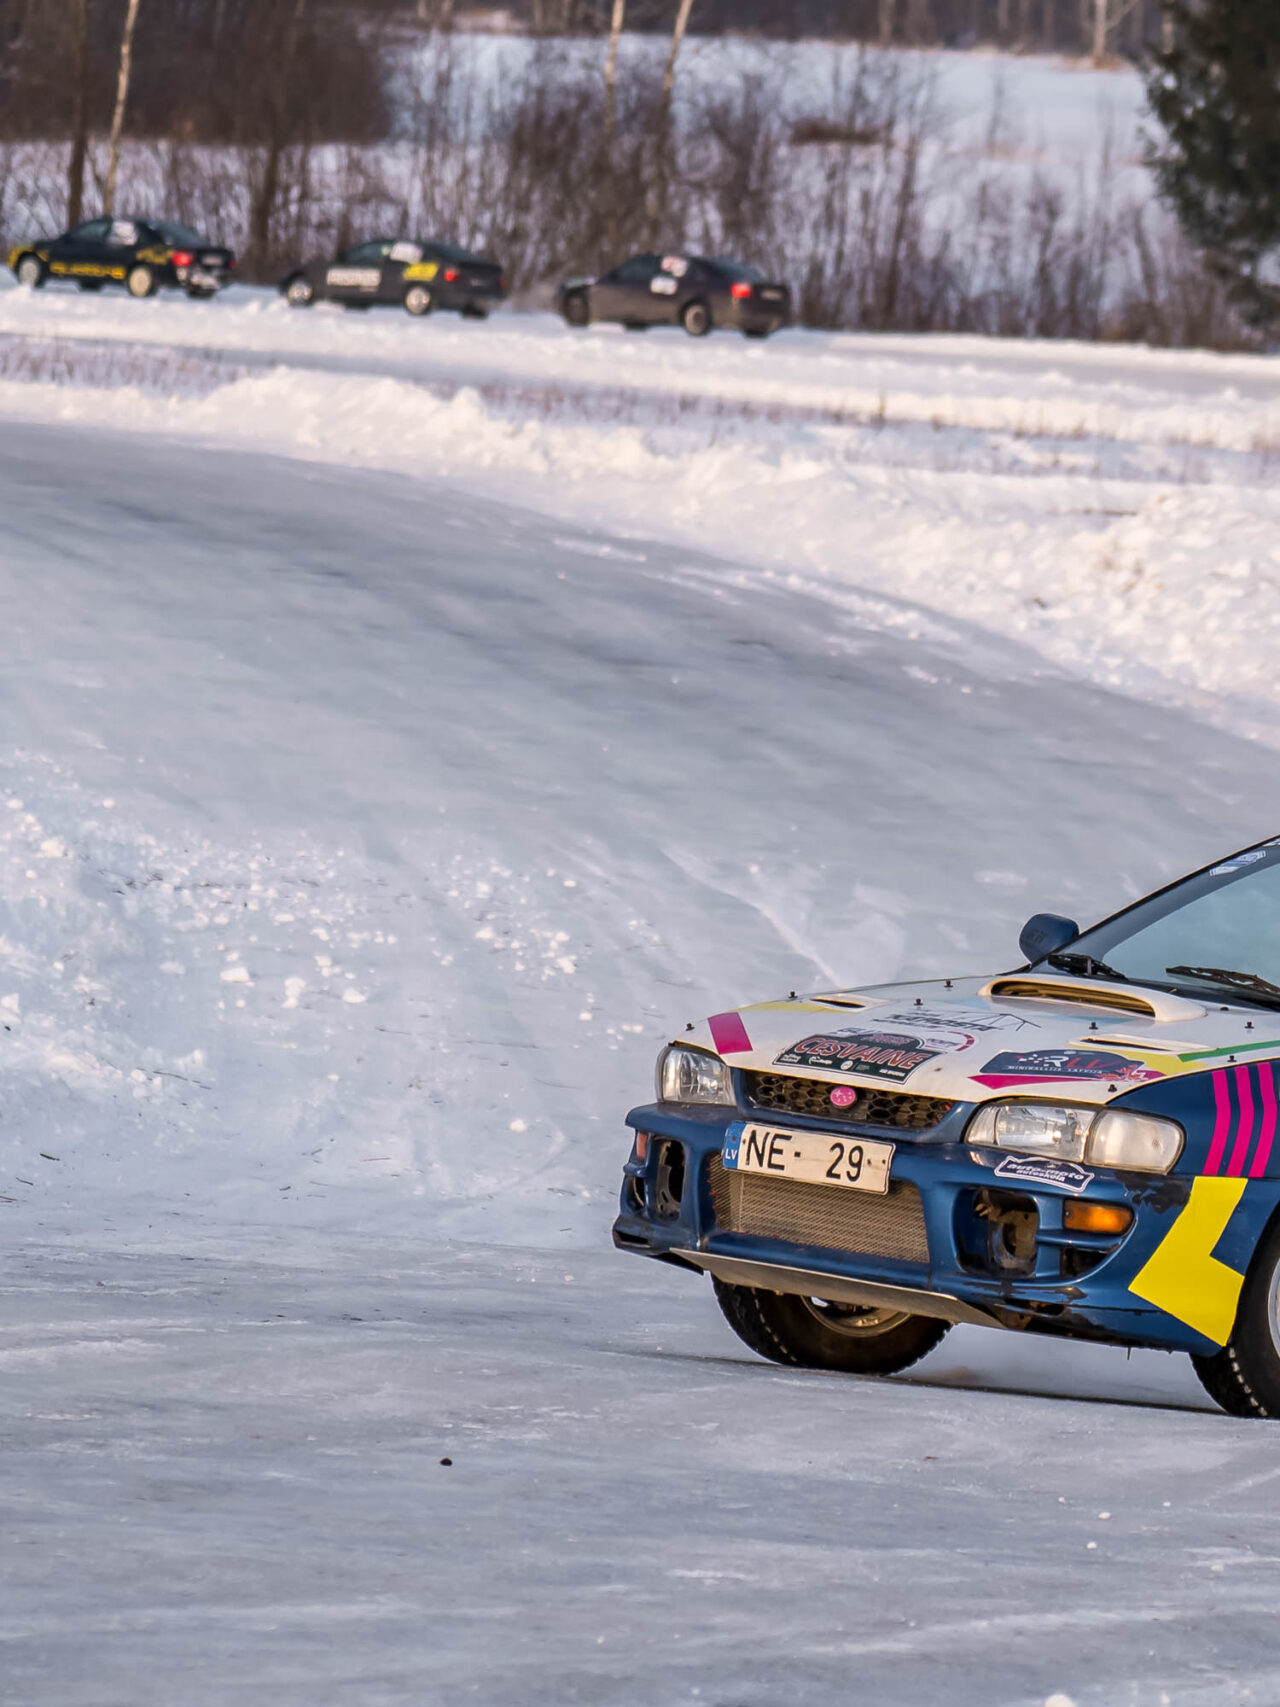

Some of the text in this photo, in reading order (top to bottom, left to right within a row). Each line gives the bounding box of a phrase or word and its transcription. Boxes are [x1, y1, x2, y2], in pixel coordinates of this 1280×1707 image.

[794, 1037, 931, 1070] CESVAINE
[724, 1148, 738, 1160] LV
[826, 1142, 864, 1182] 29
[1006, 1163, 1085, 1181] auto-moto
